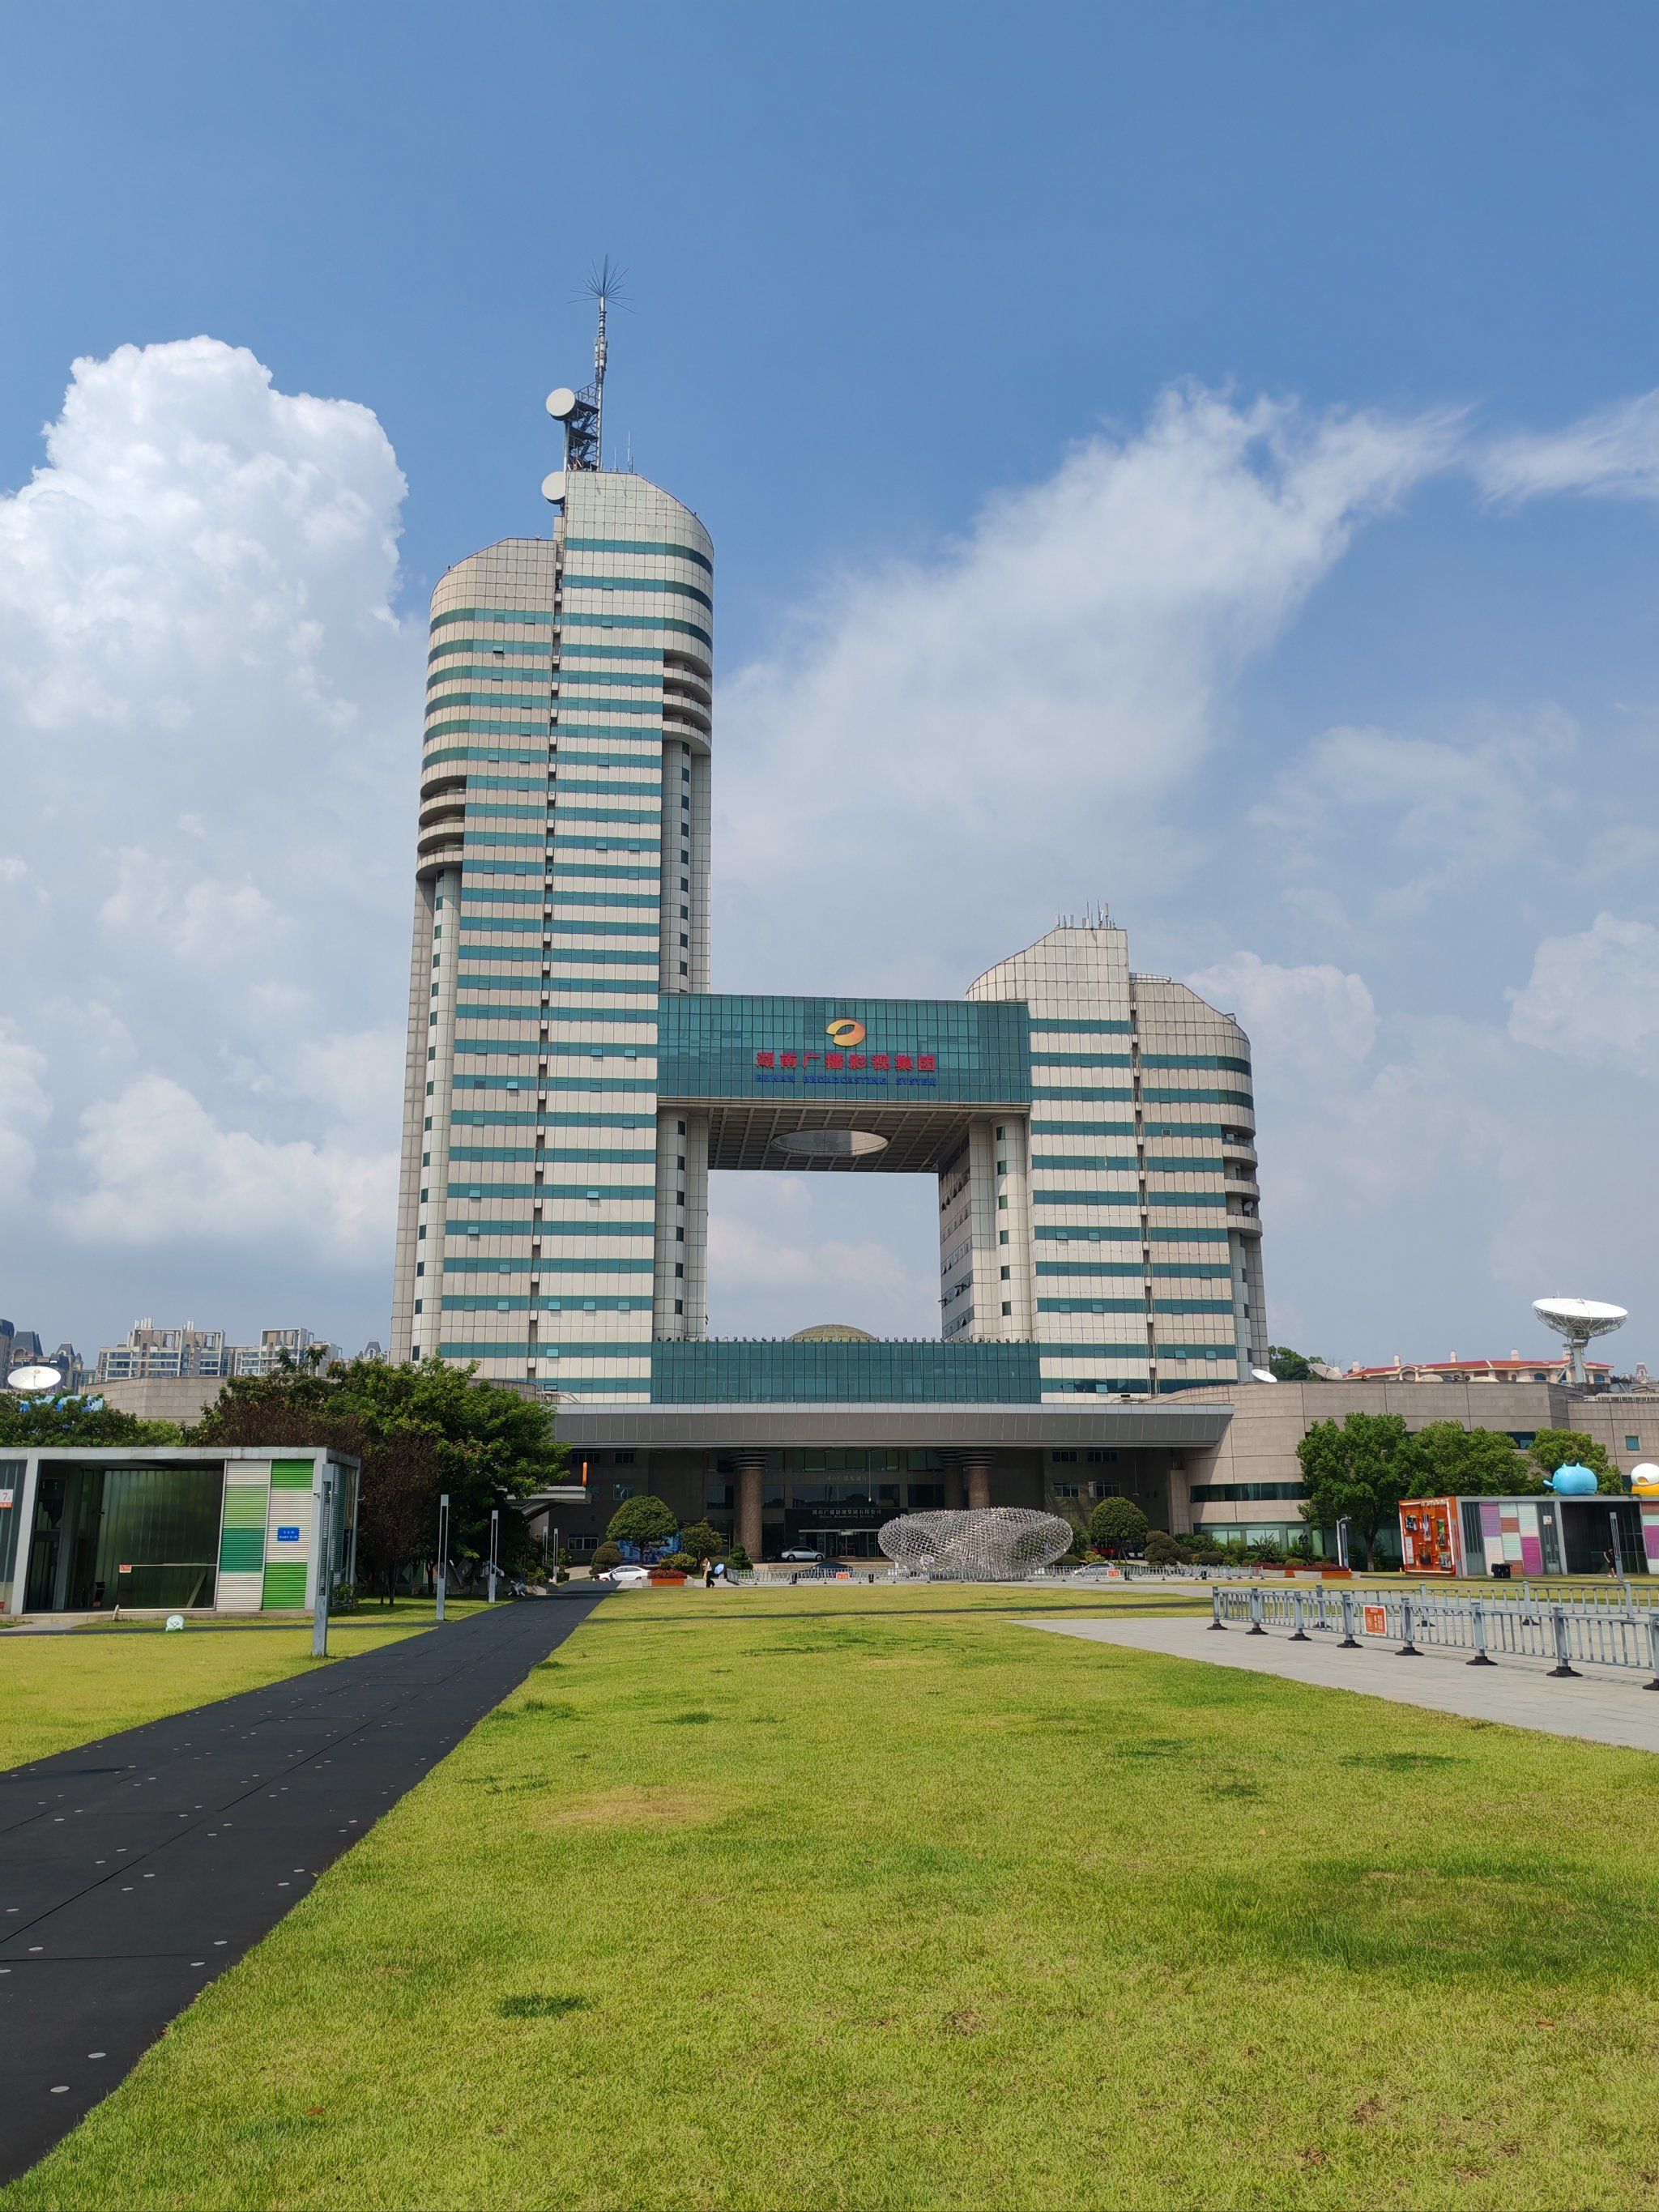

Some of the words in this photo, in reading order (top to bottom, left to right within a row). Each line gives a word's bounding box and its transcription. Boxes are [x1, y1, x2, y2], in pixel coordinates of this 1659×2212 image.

[757, 1052, 936, 1072] 湖南广播影视集团
[803, 1076, 888, 1085] BROADCASTING
[896, 1077, 937, 1087] SYSTEM
